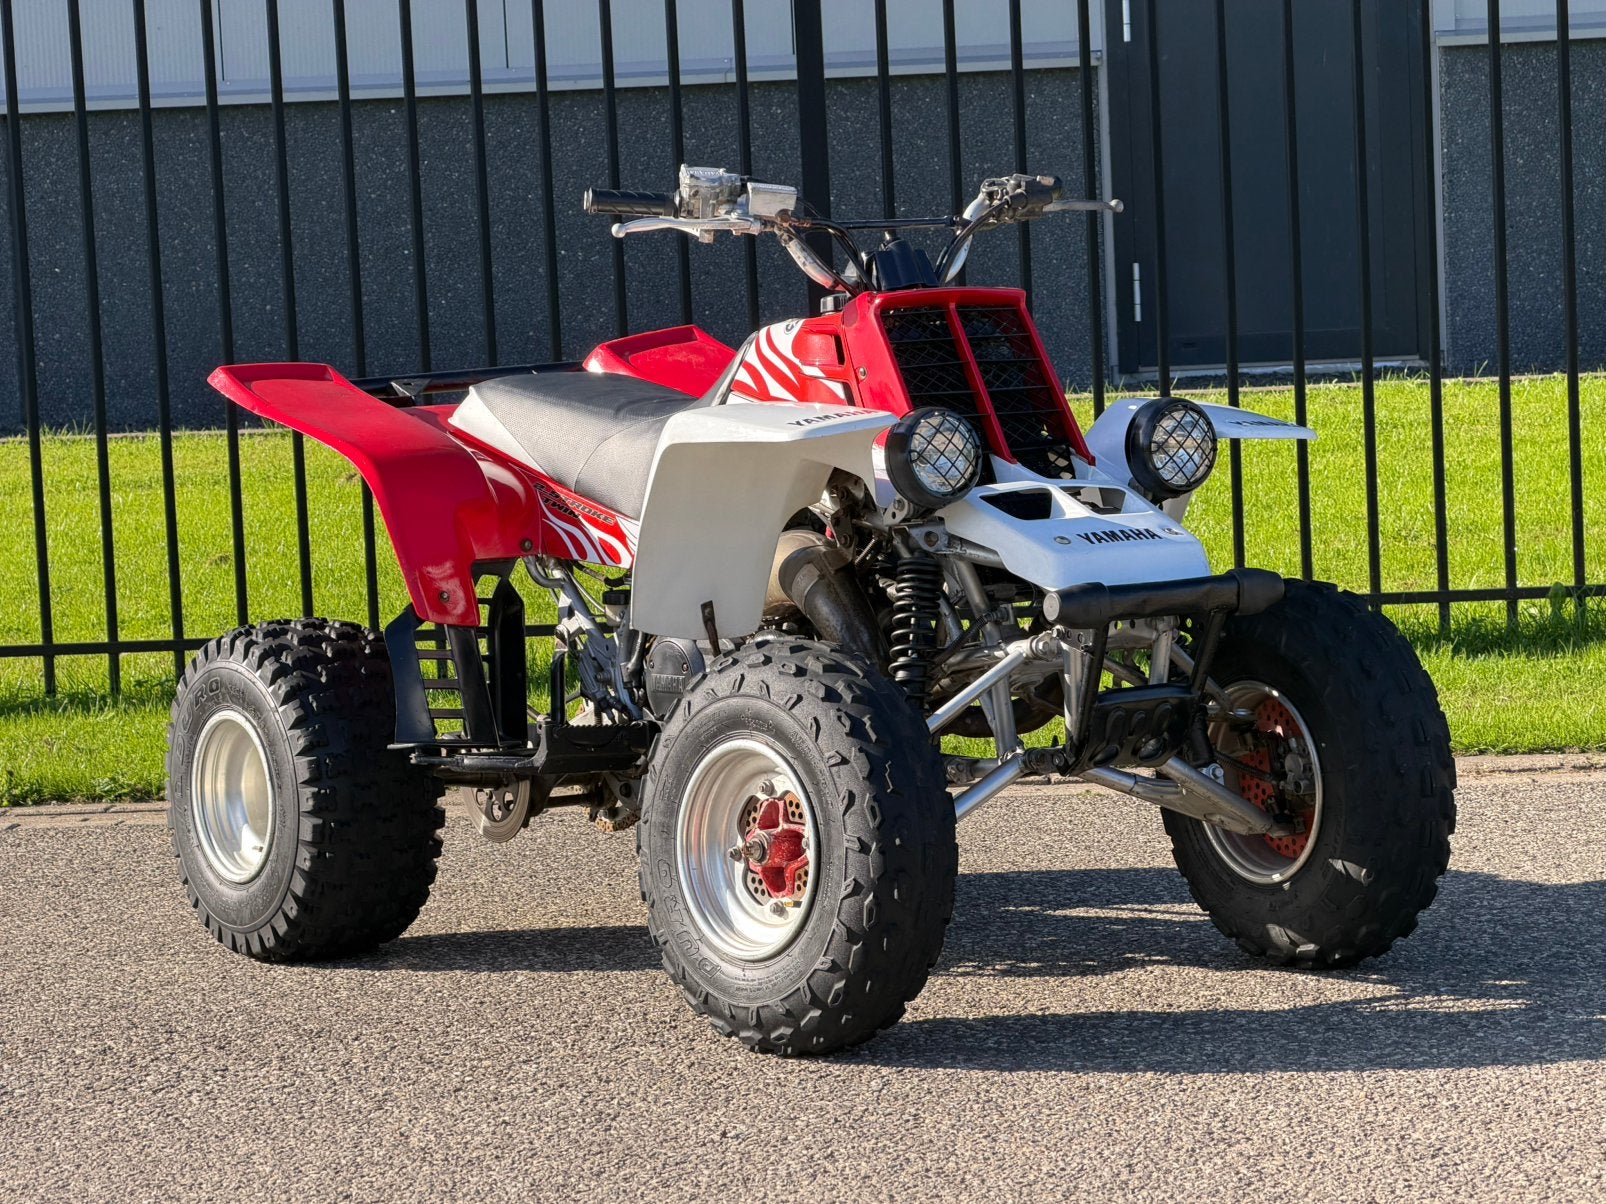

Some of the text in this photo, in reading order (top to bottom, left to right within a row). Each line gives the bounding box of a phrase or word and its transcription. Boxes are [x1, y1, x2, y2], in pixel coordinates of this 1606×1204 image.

[787, 409, 879, 426] YAMAHA
[543, 497, 581, 519] TWIN
[1076, 528, 1163, 544] YAMAHA
[658, 859, 721, 978] DURO
